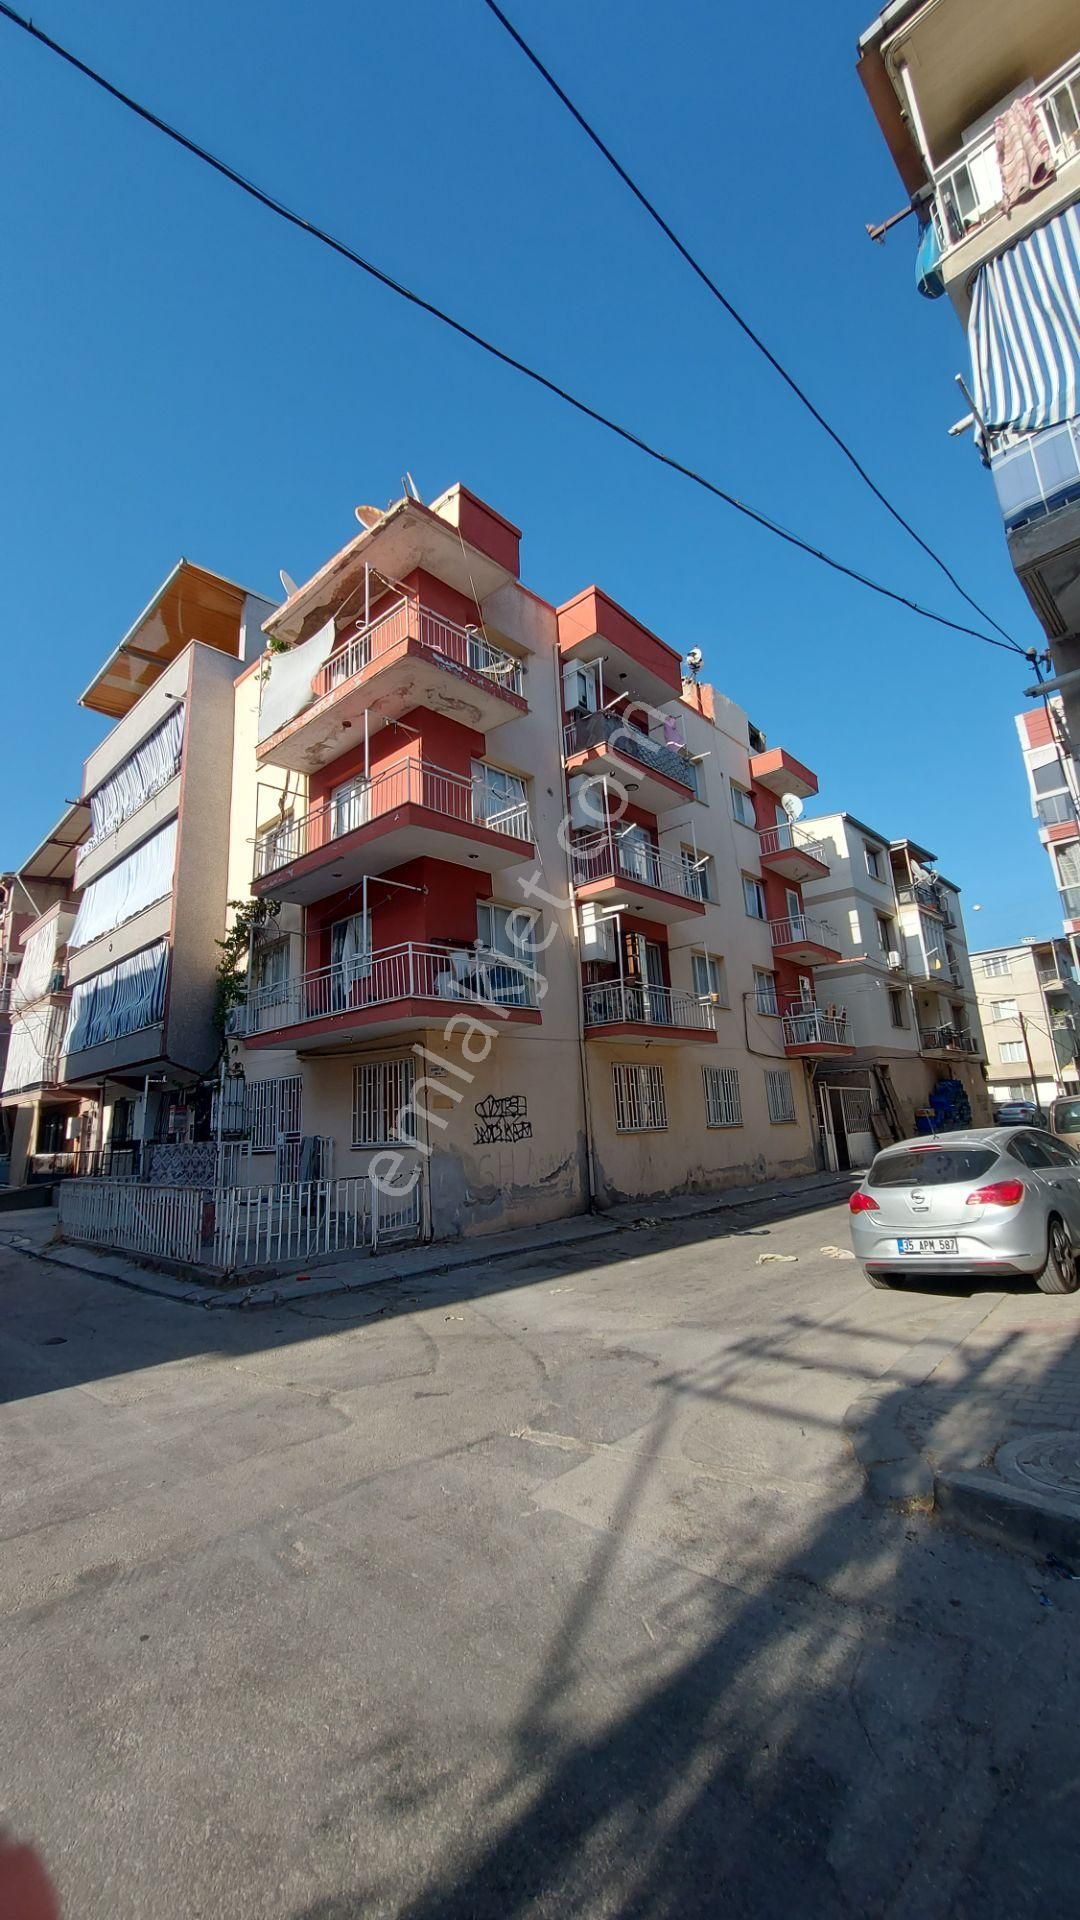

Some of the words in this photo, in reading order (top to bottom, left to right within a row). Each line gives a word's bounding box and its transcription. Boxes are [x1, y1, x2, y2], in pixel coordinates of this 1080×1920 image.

[904, 1240, 914, 1251] 35
[919, 1239, 936, 1251] APM
[938, 1239, 956, 1250] 587
